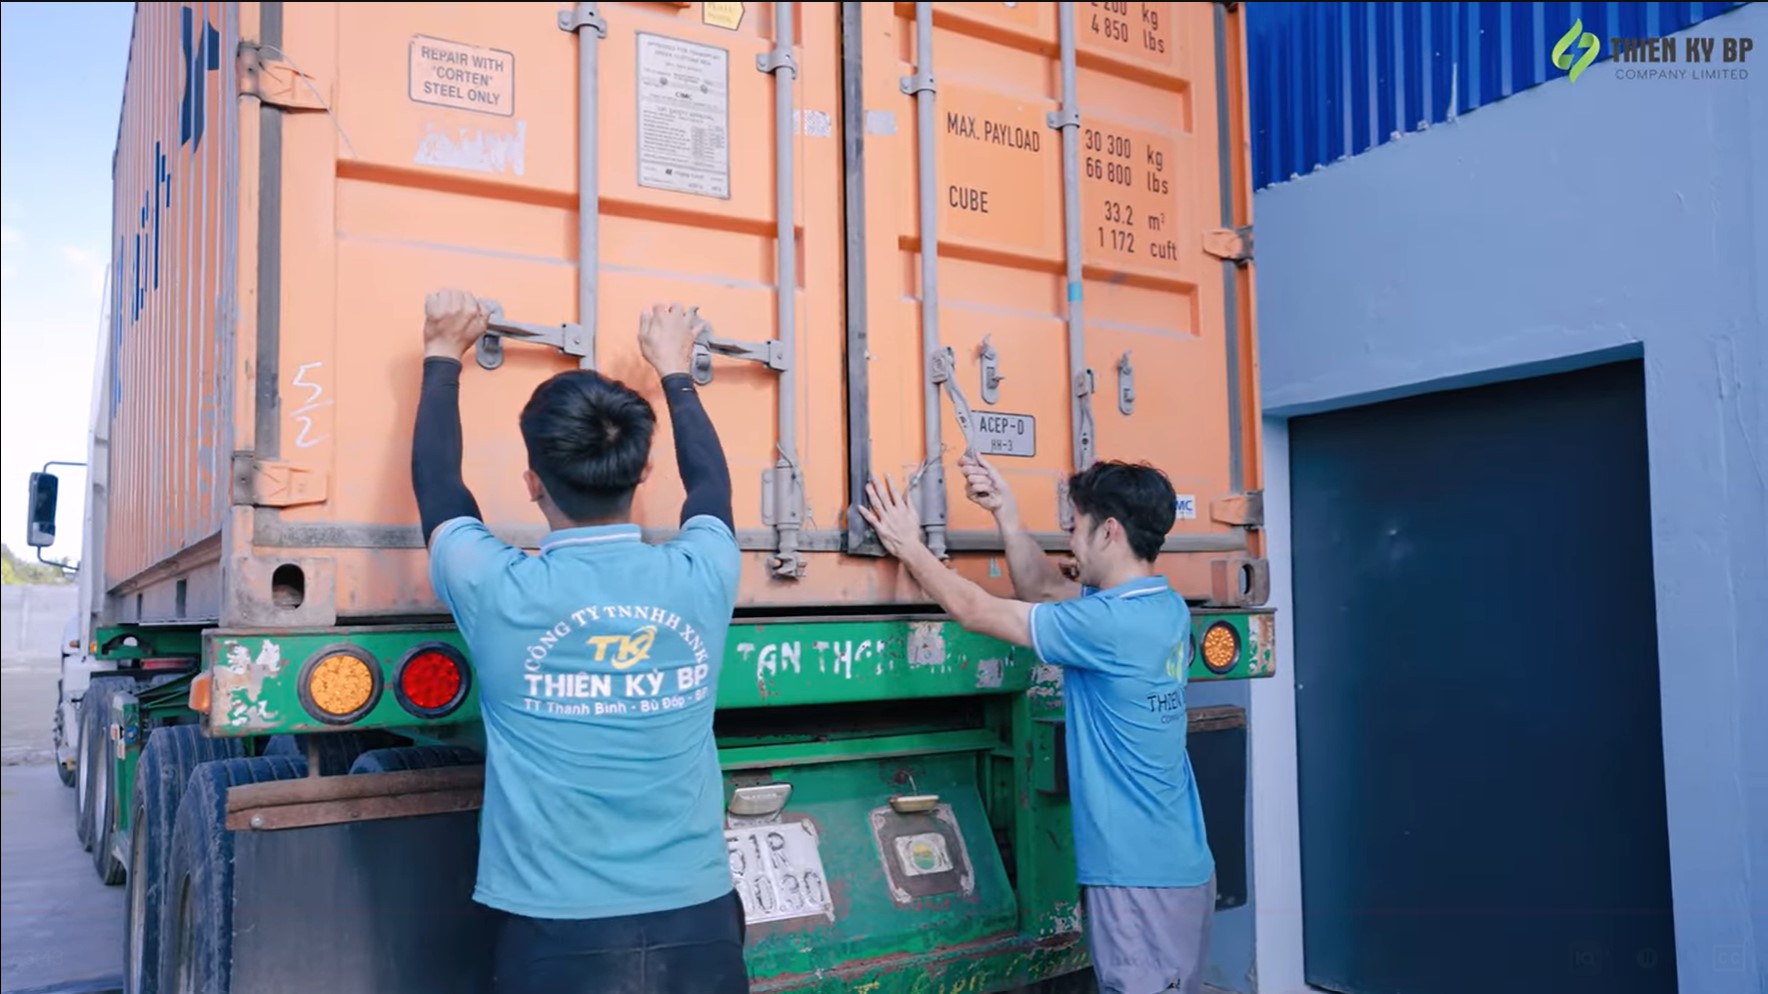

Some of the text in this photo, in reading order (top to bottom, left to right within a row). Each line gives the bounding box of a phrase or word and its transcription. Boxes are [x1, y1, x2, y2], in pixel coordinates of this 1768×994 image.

[1091, 13, 1165, 53] 4 850 lbs
[1142, 3, 1158, 31] kg
[421, 46, 504, 72] REPAIR WITH
[424, 81, 500, 105] STEEL ONLY
[947, 112, 1040, 152] MAX. PAYLOAD
[1085, 129, 1163, 172] 30 300 kg
[1086, 157, 1169, 194] 66 800 lbs
[949, 185, 988, 213] CUBE
[1105, 200, 1133, 226] 33.2
[1111, 229, 1135, 253] 172
[1150, 240, 1178, 261] cuft
[1174, 500, 1193, 511] MC
[571, 605, 600, 627] TY
[679, 624, 709, 664] XNK
[677, 663, 709, 690] BP
[524, 698, 541, 712] TT
[546, 701, 590, 716] Thanh
